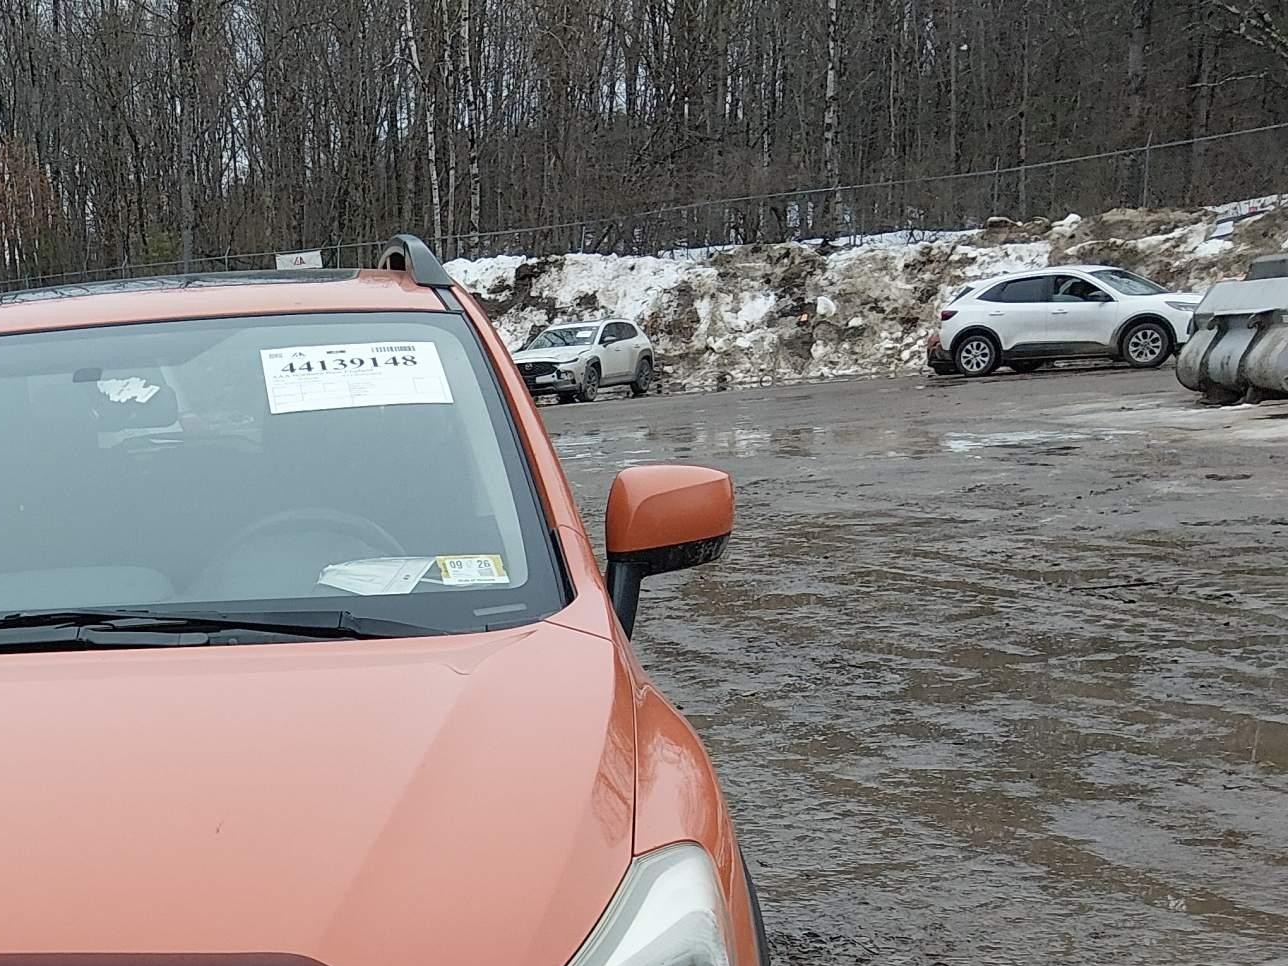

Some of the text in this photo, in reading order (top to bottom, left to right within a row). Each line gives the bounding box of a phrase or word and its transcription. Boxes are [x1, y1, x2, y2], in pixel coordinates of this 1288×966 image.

[281, 354, 418, 373] 44139148
[449, 559, 491, 569] 09 26
